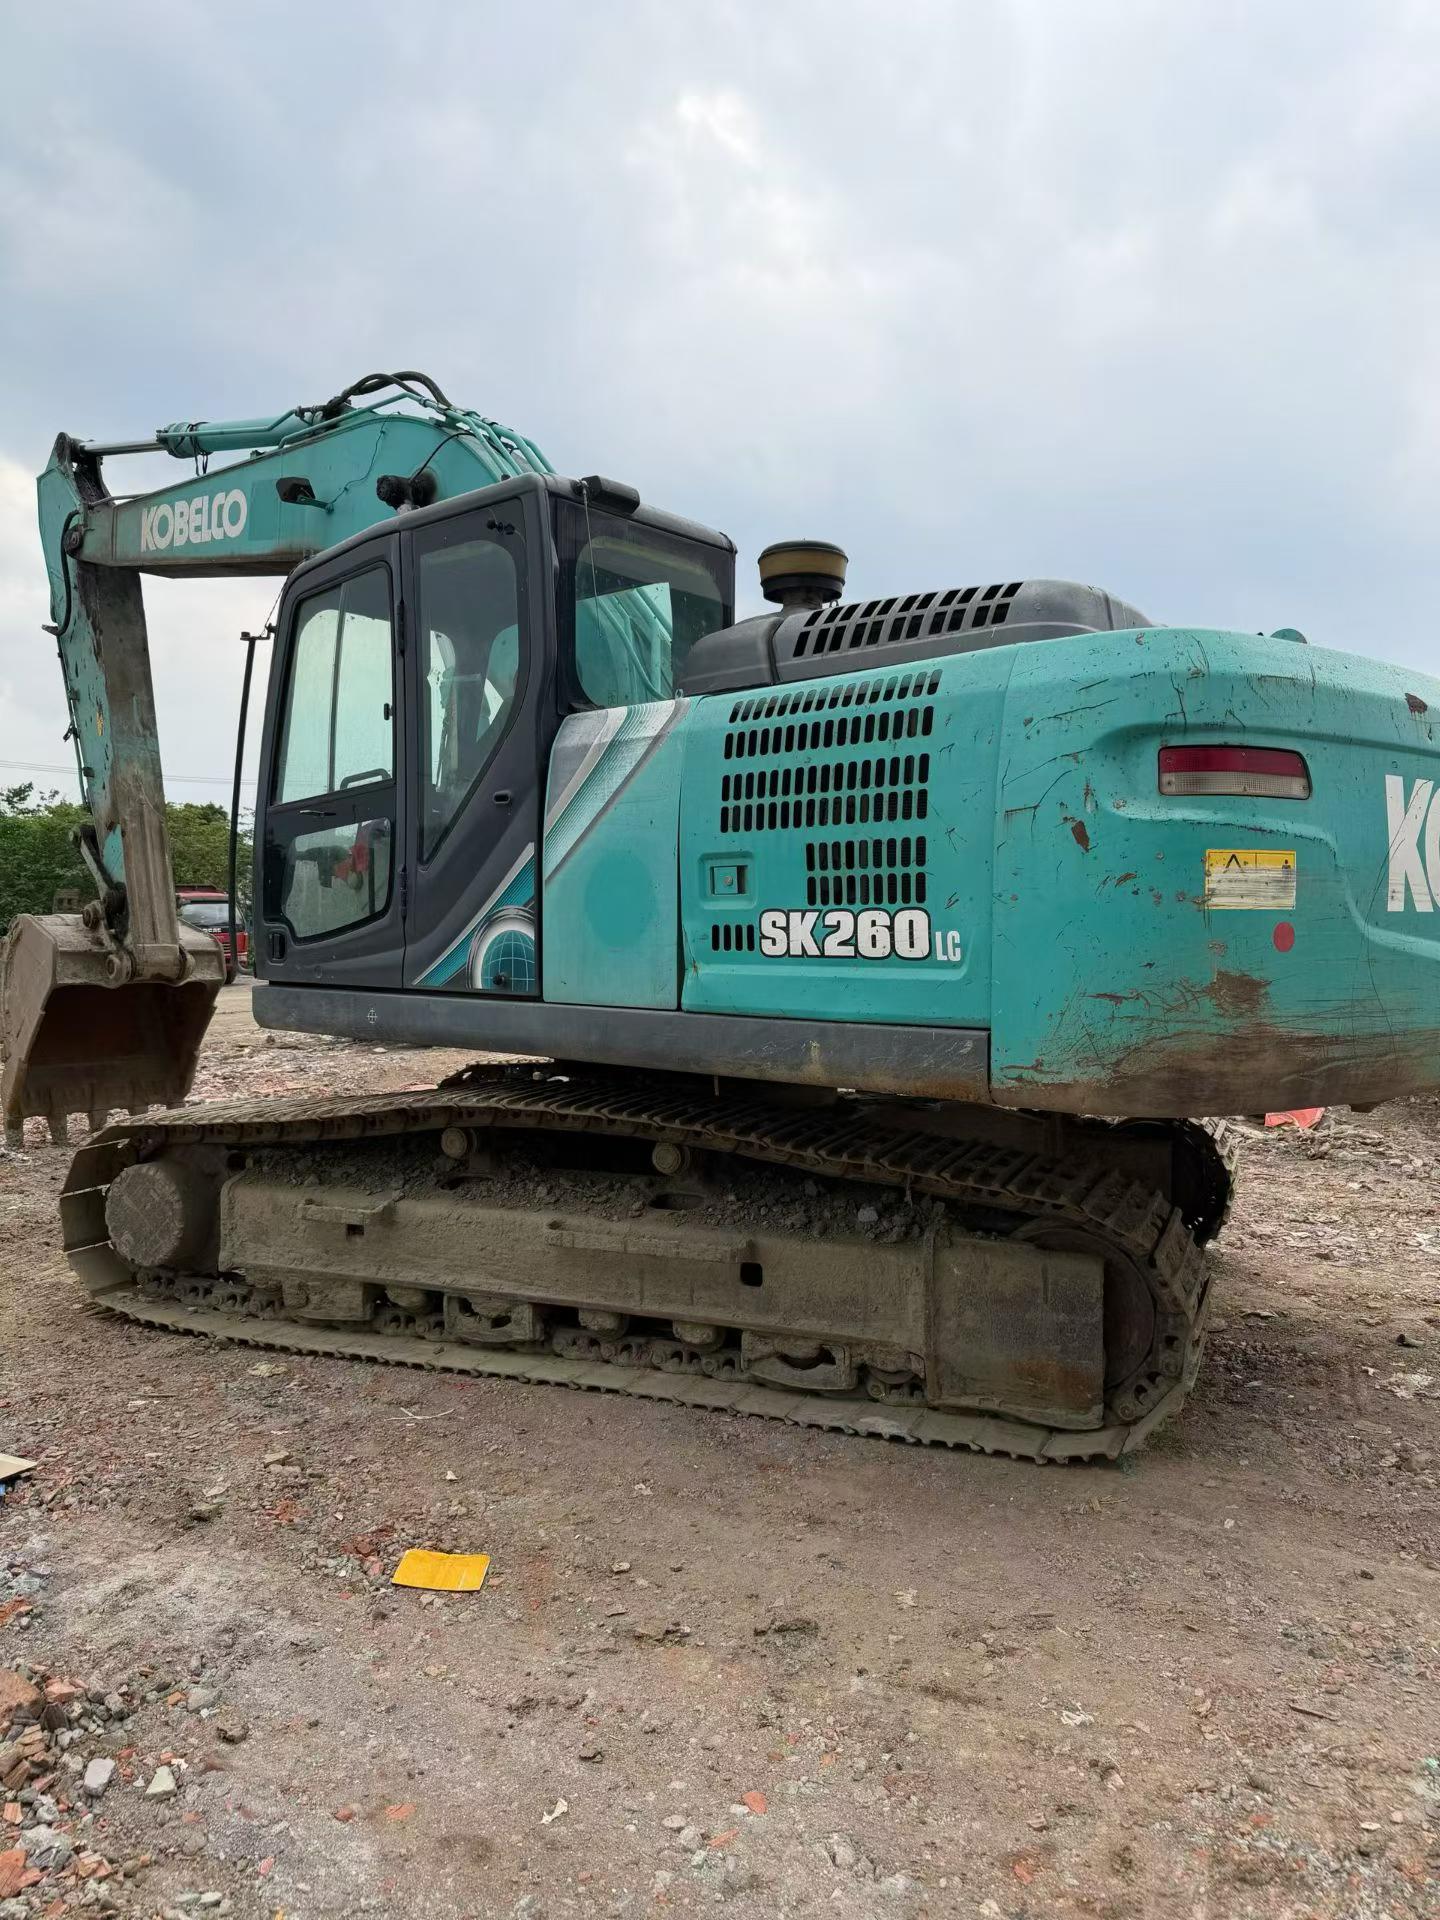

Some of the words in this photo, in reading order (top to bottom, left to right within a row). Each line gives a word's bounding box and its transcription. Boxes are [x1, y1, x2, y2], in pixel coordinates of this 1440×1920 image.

[141, 489, 248, 552] KOBELCO
[1385, 774, 1440, 912] K
[760, 908, 931, 959] SK260
[935, 930, 961, 961] LC
